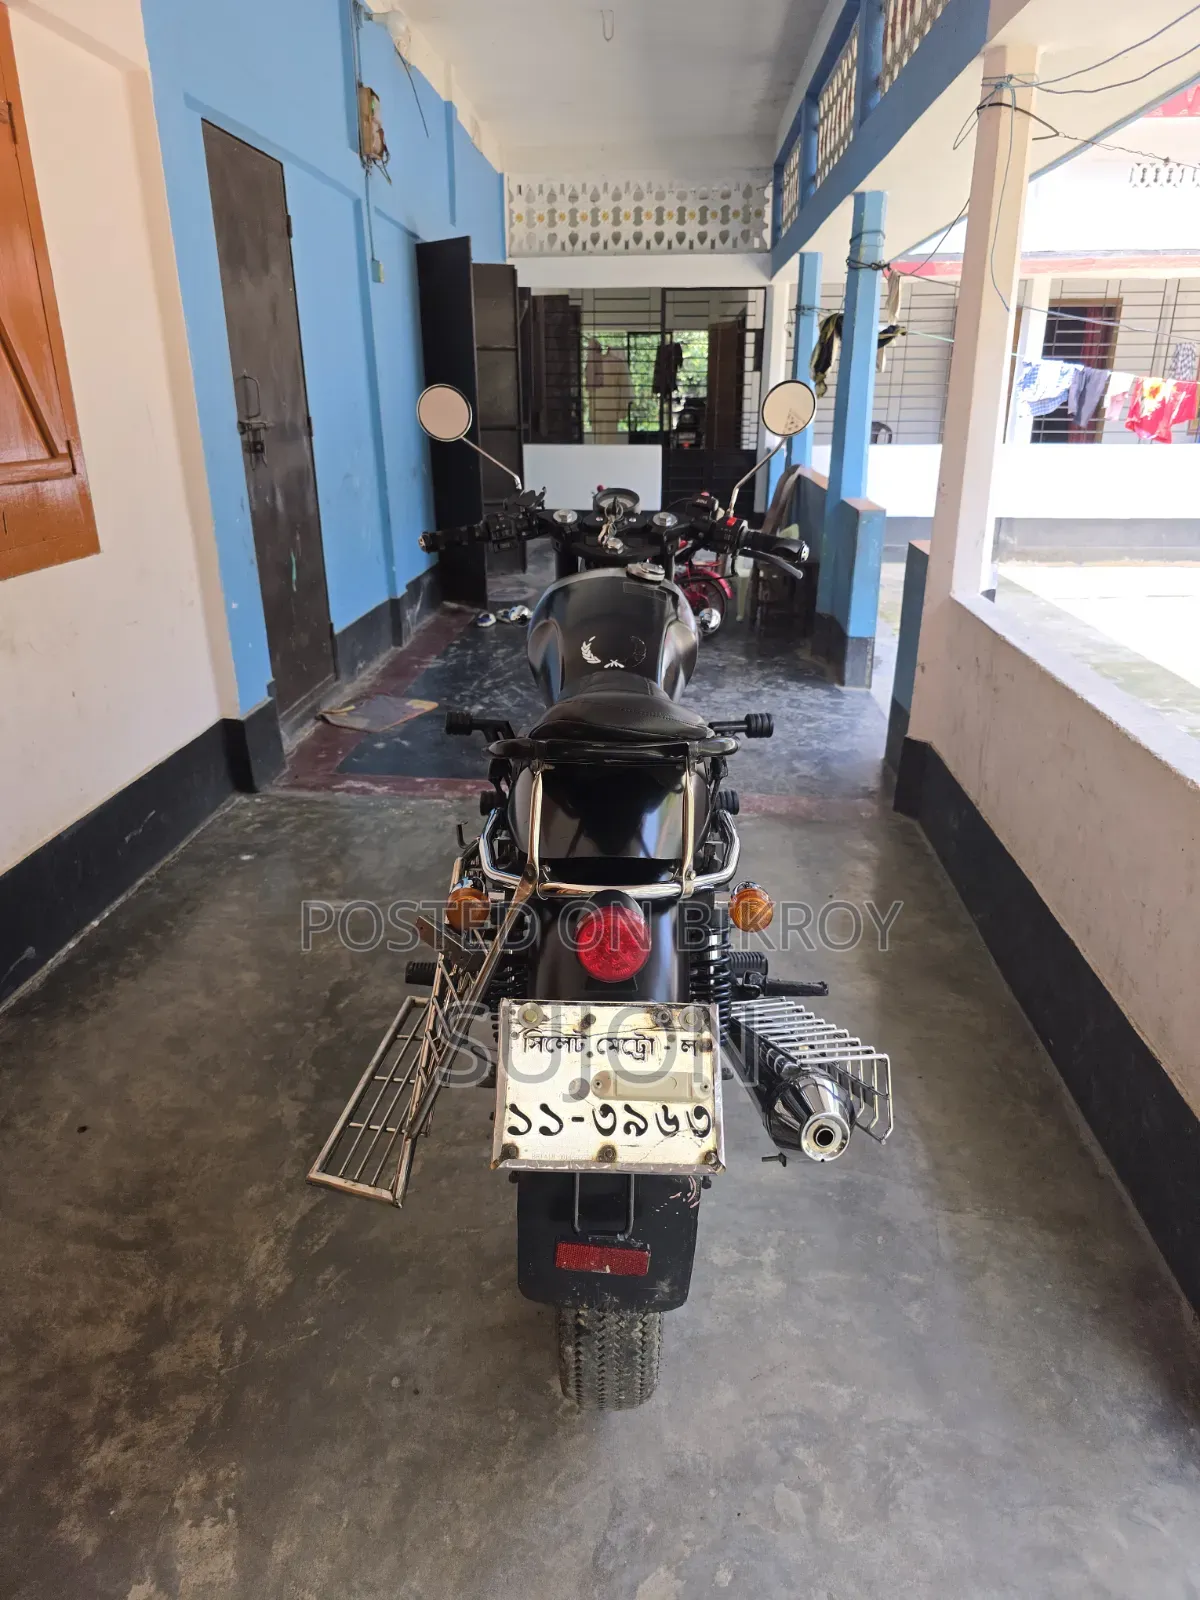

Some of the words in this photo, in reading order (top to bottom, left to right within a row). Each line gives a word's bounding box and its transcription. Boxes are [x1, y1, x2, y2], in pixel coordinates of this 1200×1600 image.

[523, 1026, 587, 1055] সিলেট
[596, 1033, 655, 1062] মেট্রো
[506, 1103, 713, 1137] ১১-৩৯৬৩
